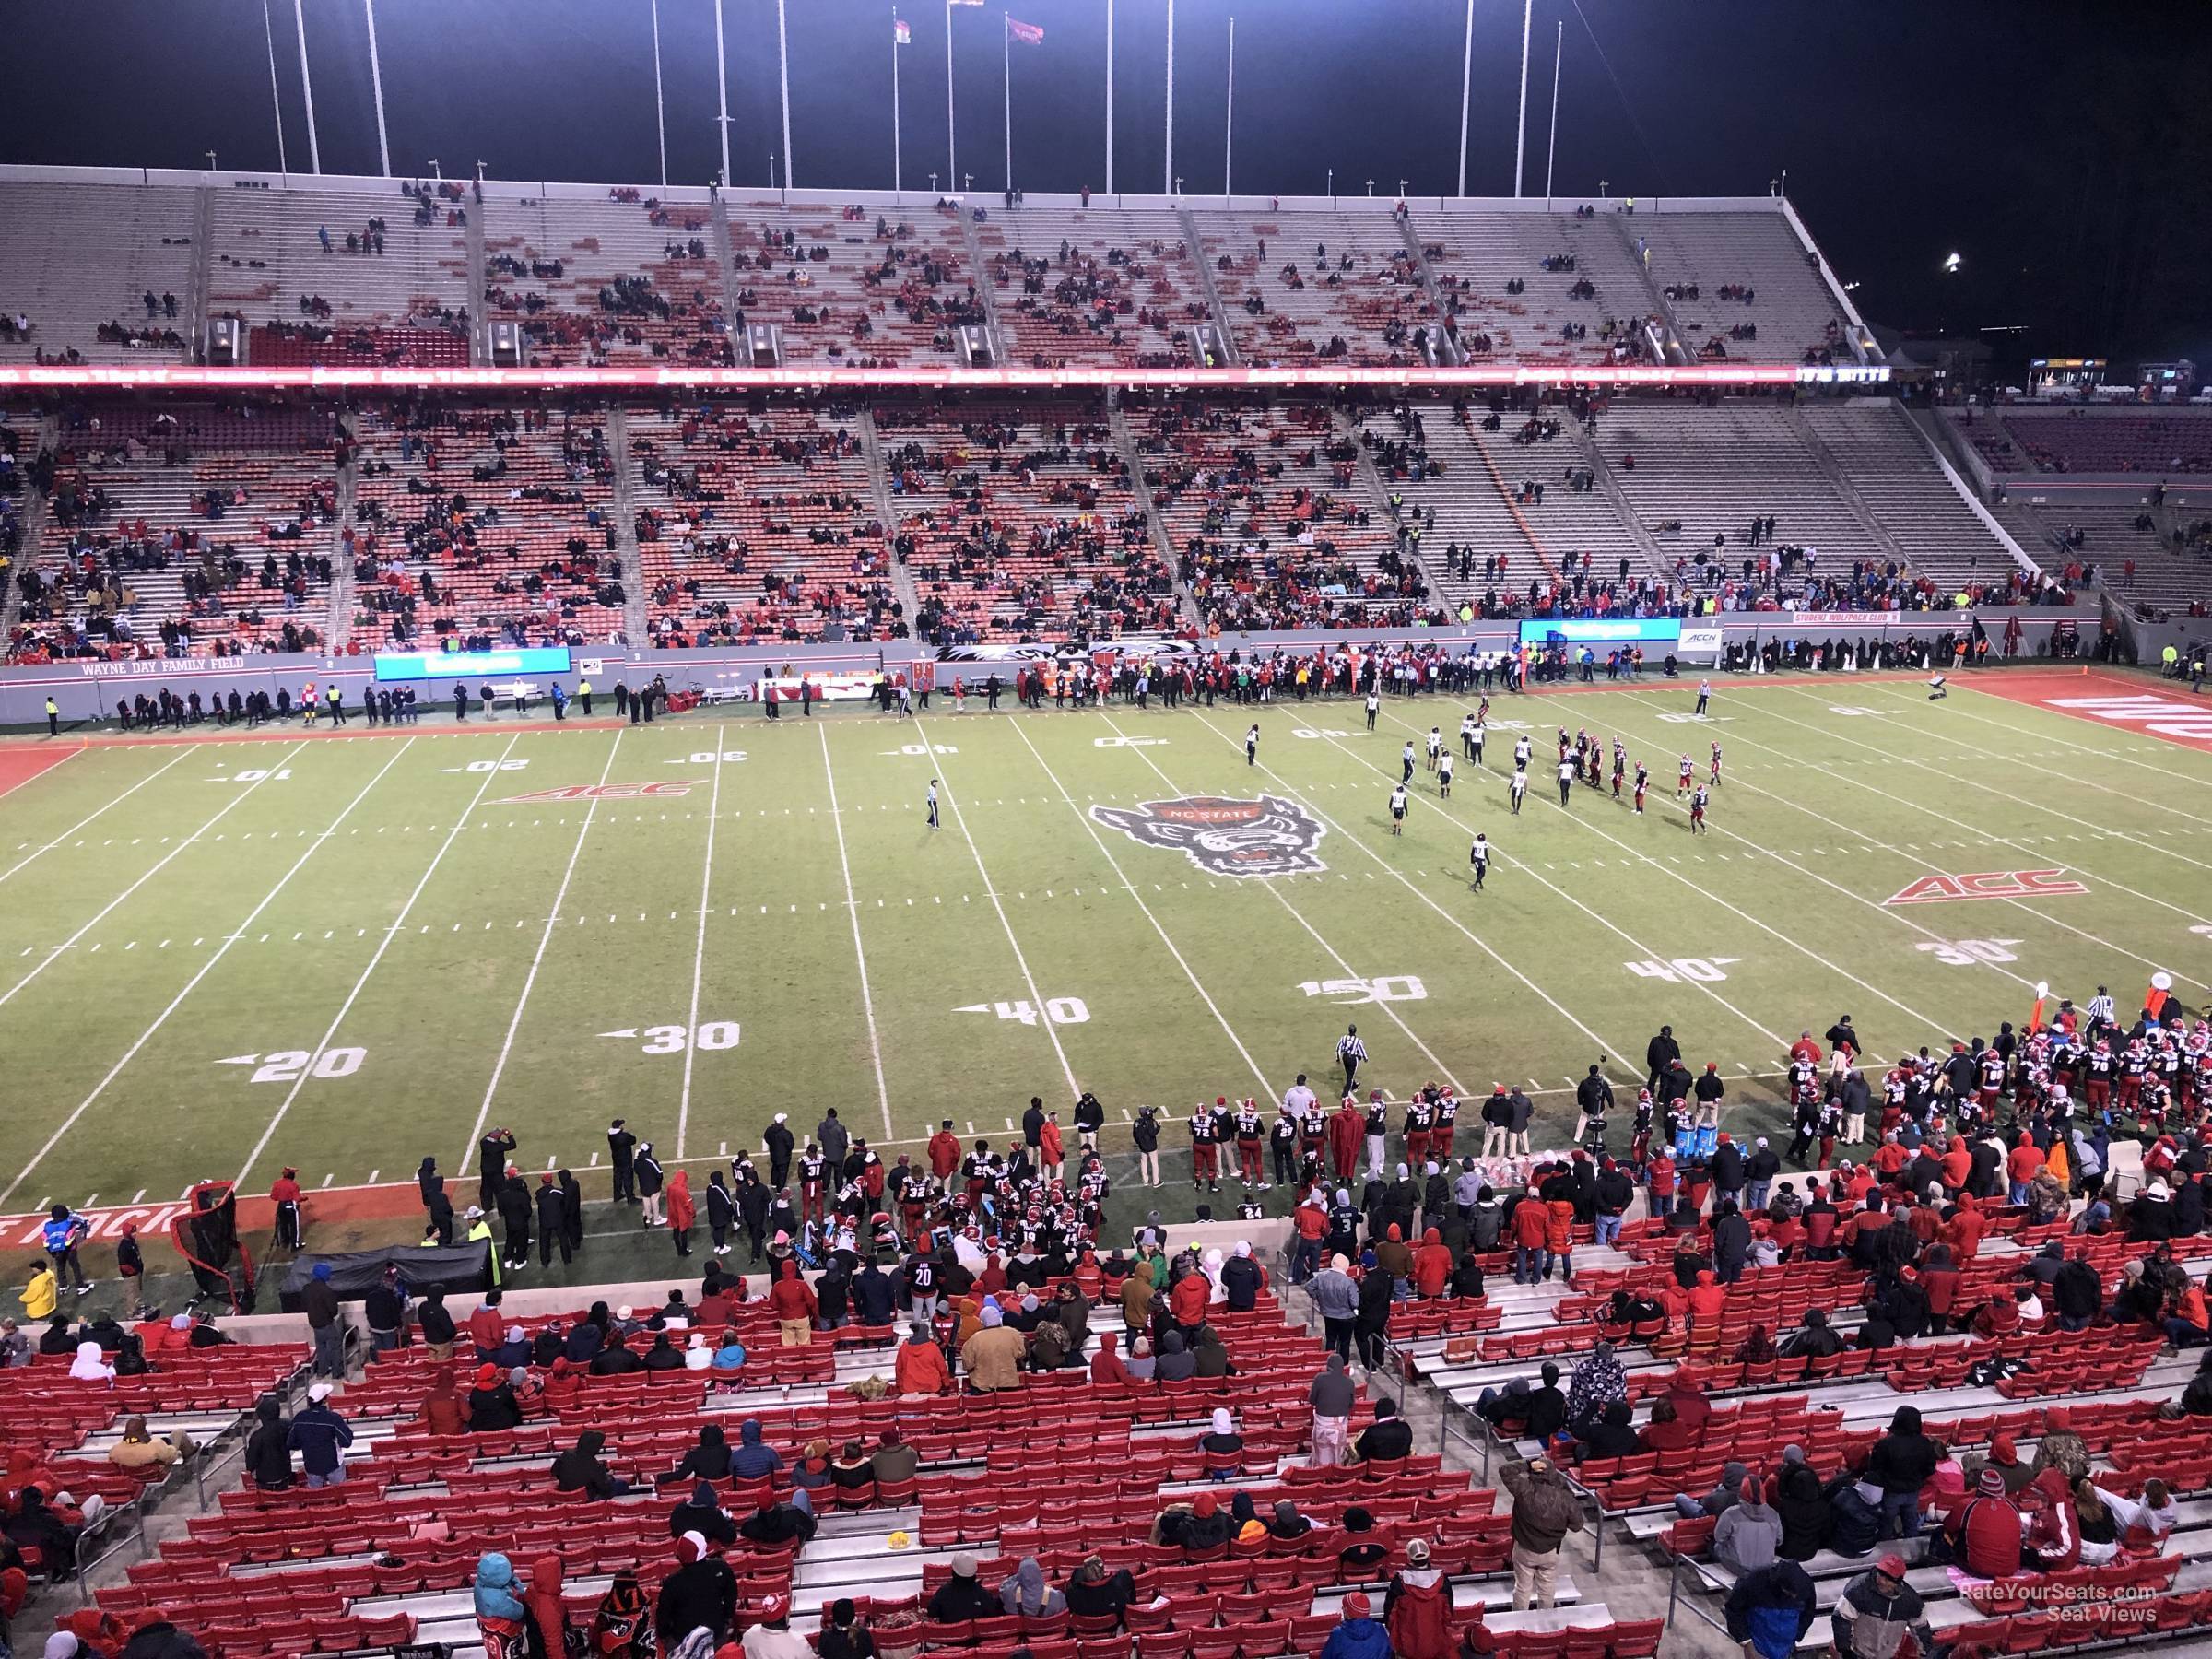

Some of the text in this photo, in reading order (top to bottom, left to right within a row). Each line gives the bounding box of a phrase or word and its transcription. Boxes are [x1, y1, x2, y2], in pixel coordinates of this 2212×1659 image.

[81, 656, 244, 676] WAYNE DAY FAMILY FIELD
[480, 781, 710, 805] ACC
[1201, 810, 1253, 819] STATE
[1879, 868, 2091, 905] ACC
[1914, 939, 2018, 965] 30
[1623, 958, 1728, 982] 40
[993, 996, 1090, 1026] 40
[641, 1021, 741, 1054] 30
[250, 1047, 368, 1083] 20
[2091, 1061, 2109, 1072] 70
[1416, 1114, 1430, 1125] 75
[1194, 1127, 1210, 1137] 72
[1240, 1123, 1254, 1133] 93
[807, 1165, 821, 1176] 31
[909, 1187, 926, 1197] 32
[1244, 1207, 1262, 1219] 24
[1342, 1219, 1351, 1233] 3
[914, 1268, 932, 1286] 20
